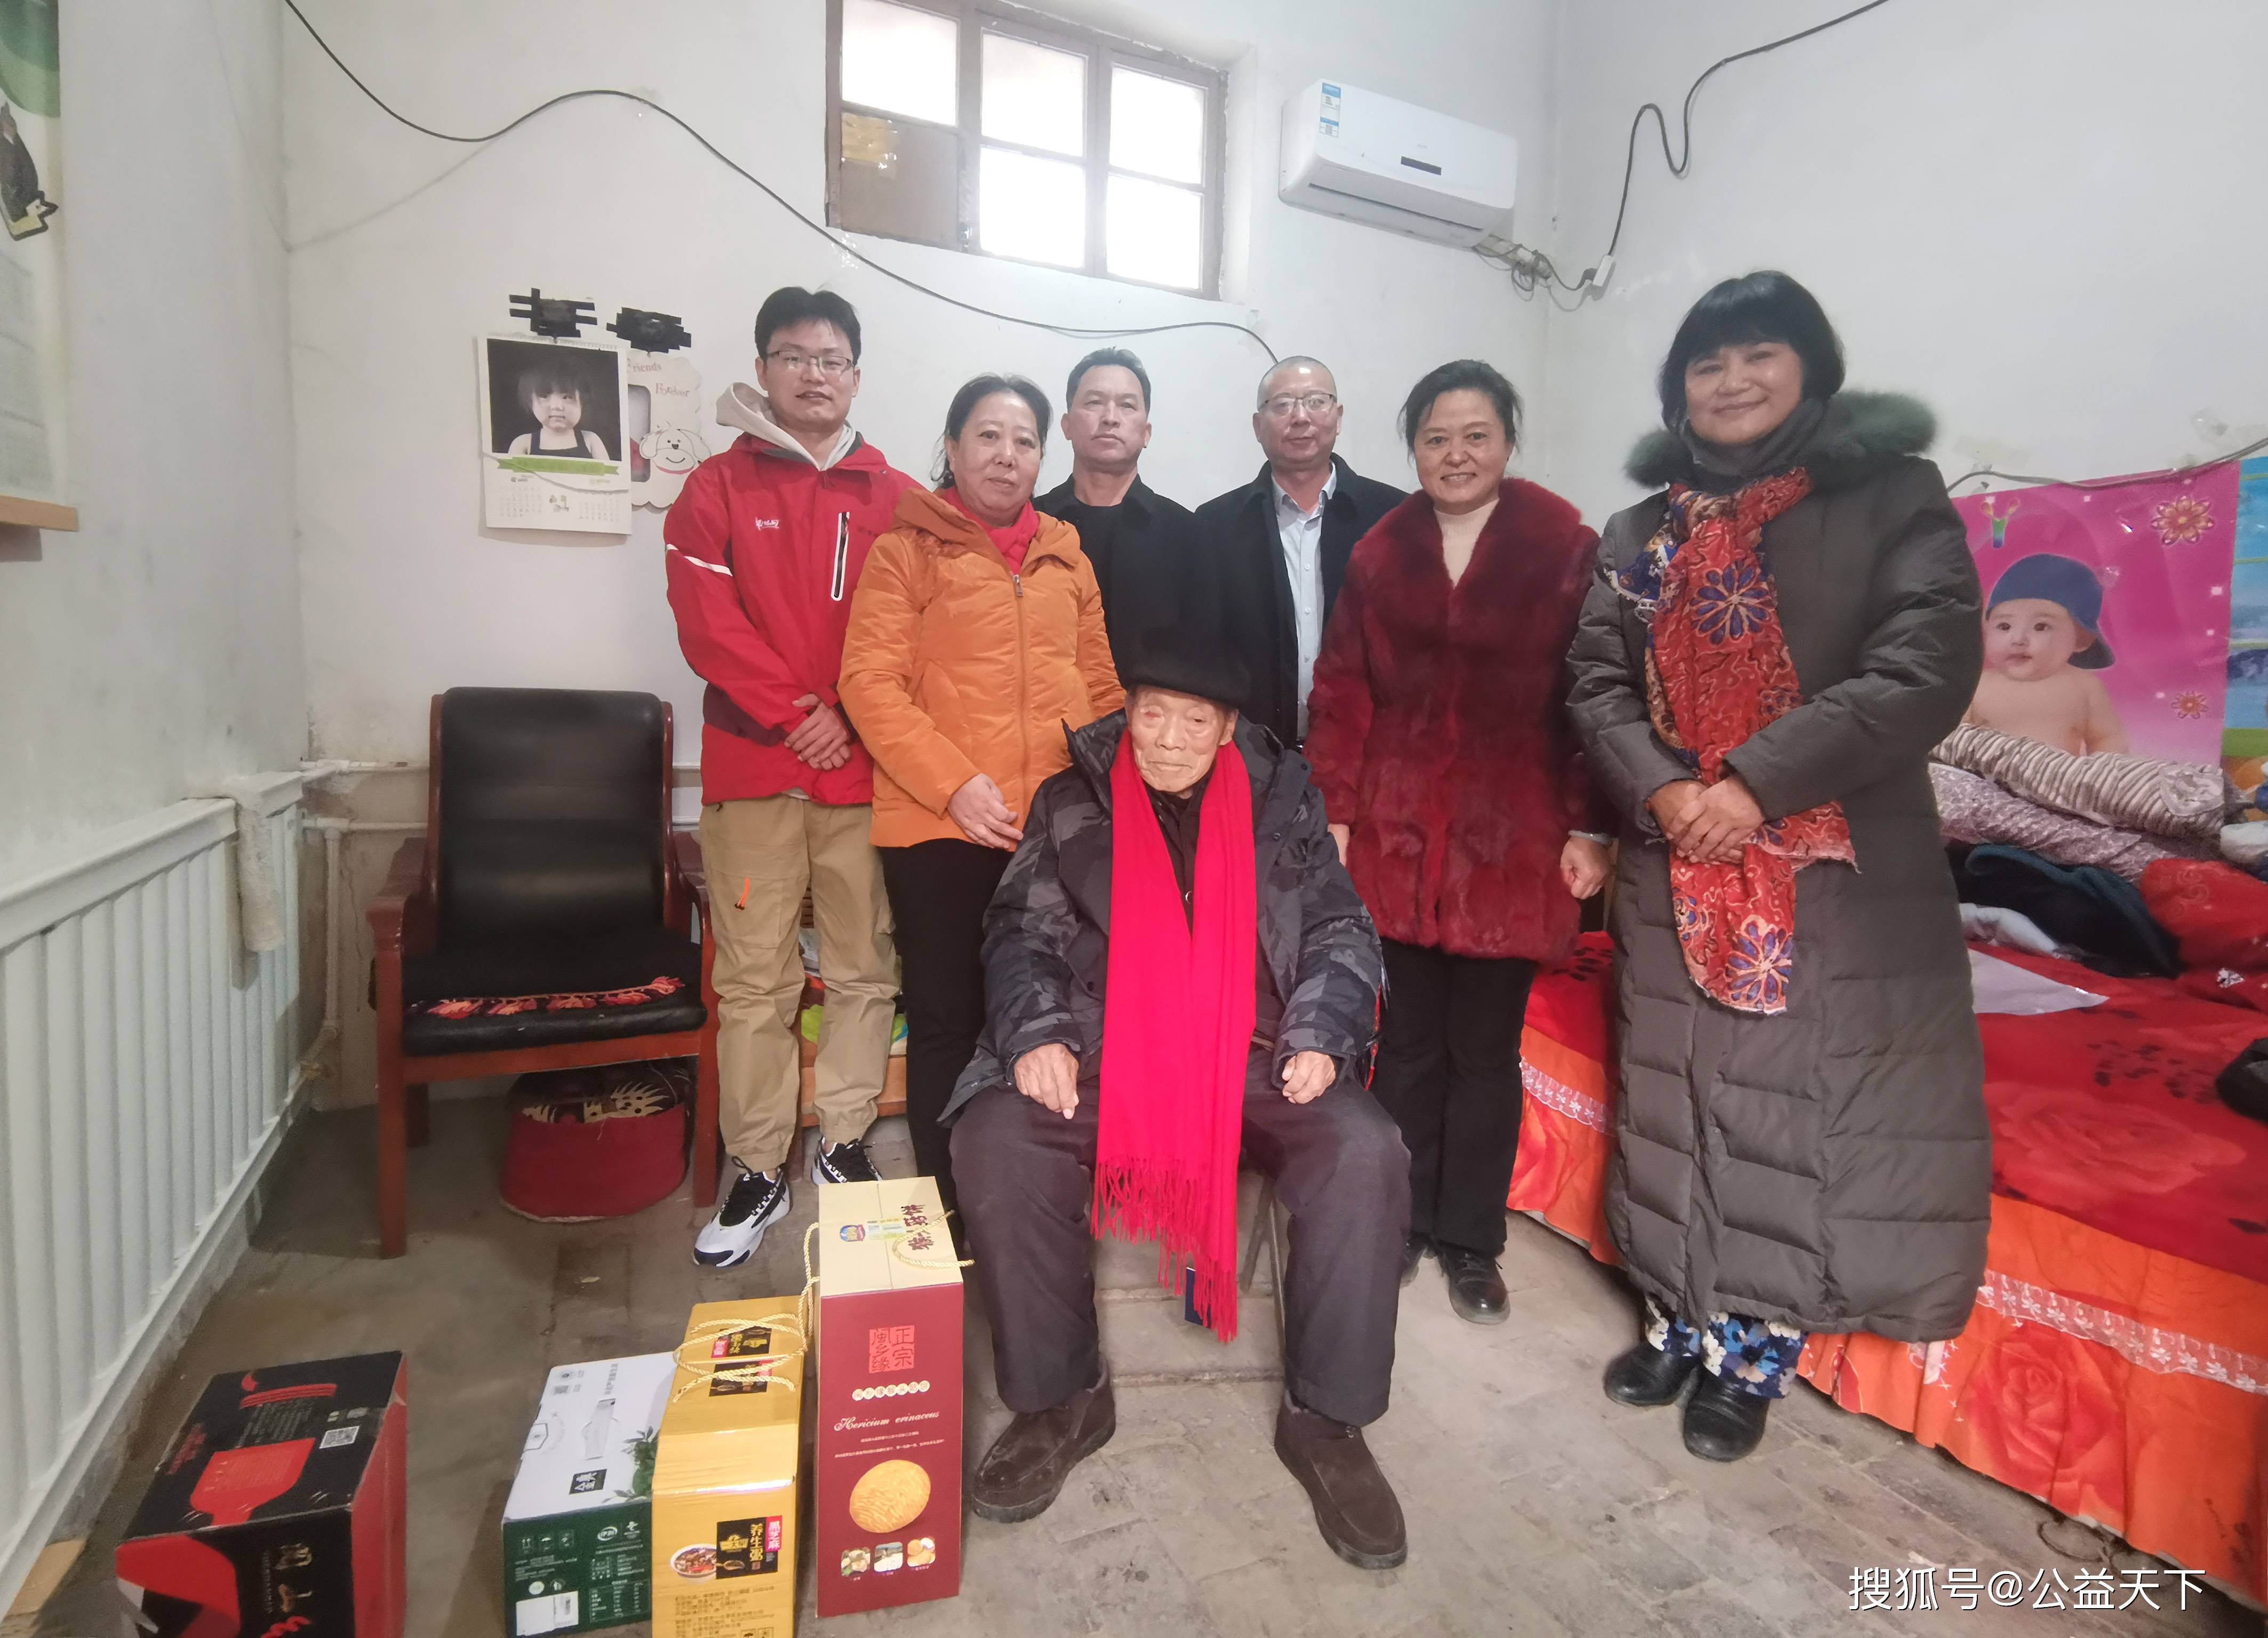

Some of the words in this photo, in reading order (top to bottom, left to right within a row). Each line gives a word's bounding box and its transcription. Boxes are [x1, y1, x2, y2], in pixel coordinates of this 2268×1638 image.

[656, 382, 690, 397] Forever
[891, 1327, 914, 1367] 正宗
[834, 1417, 890, 1432] Hericium
[895, 1411, 940, 1424] erinaceus
[749, 1523, 763, 1562] 养生粥
